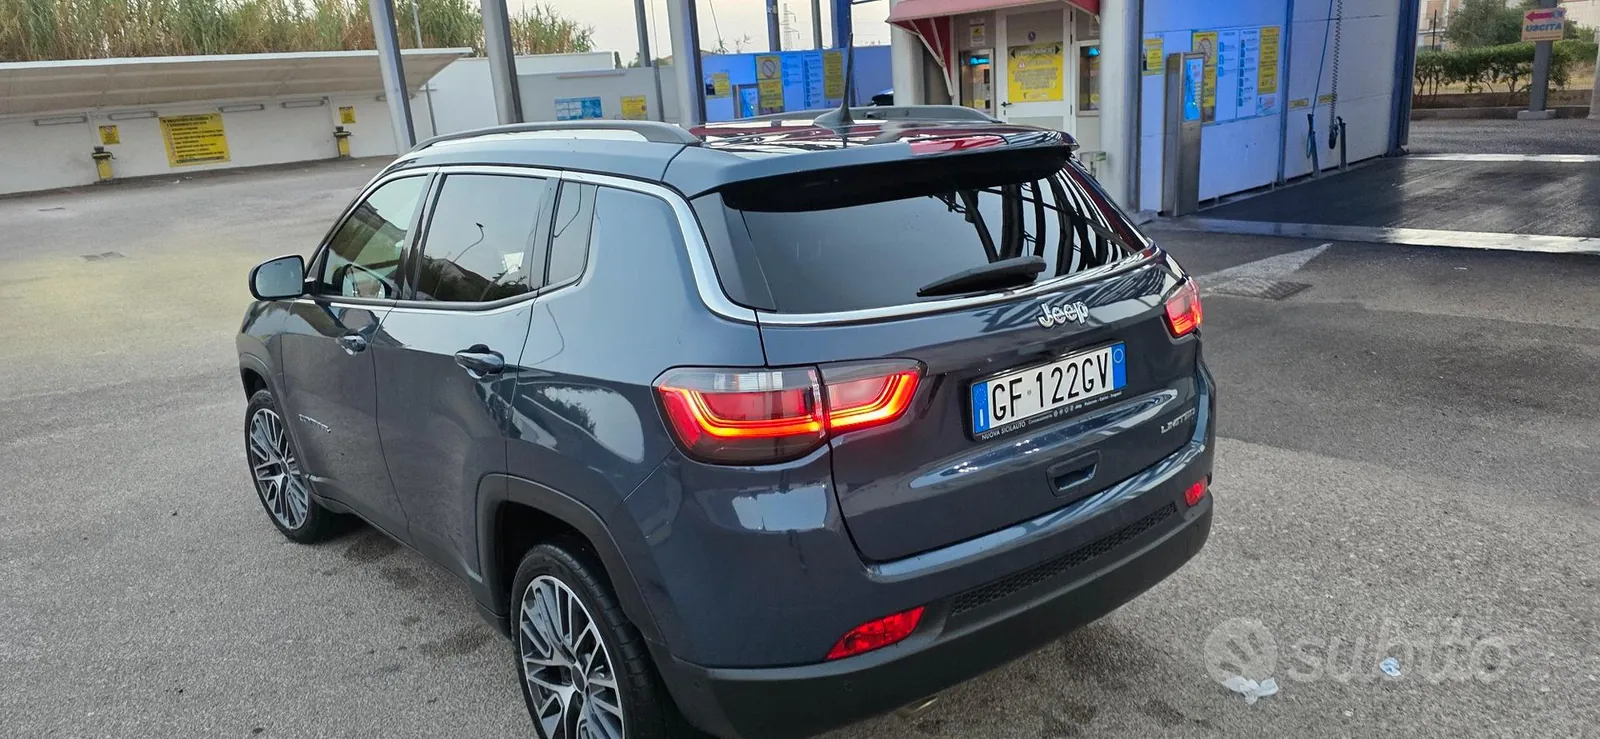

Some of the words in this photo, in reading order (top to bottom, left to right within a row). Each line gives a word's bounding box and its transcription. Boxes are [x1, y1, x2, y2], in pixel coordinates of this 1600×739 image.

[1526, 22, 1562, 32] USCITA
[1038, 301, 1088, 328] Jeep
[992, 377, 1022, 421] GF
[1036, 352, 1108, 408] 122GV
[981, 429, 1000, 440] NUOVA
[1001, 421, 1026, 434] SICILAUTO
